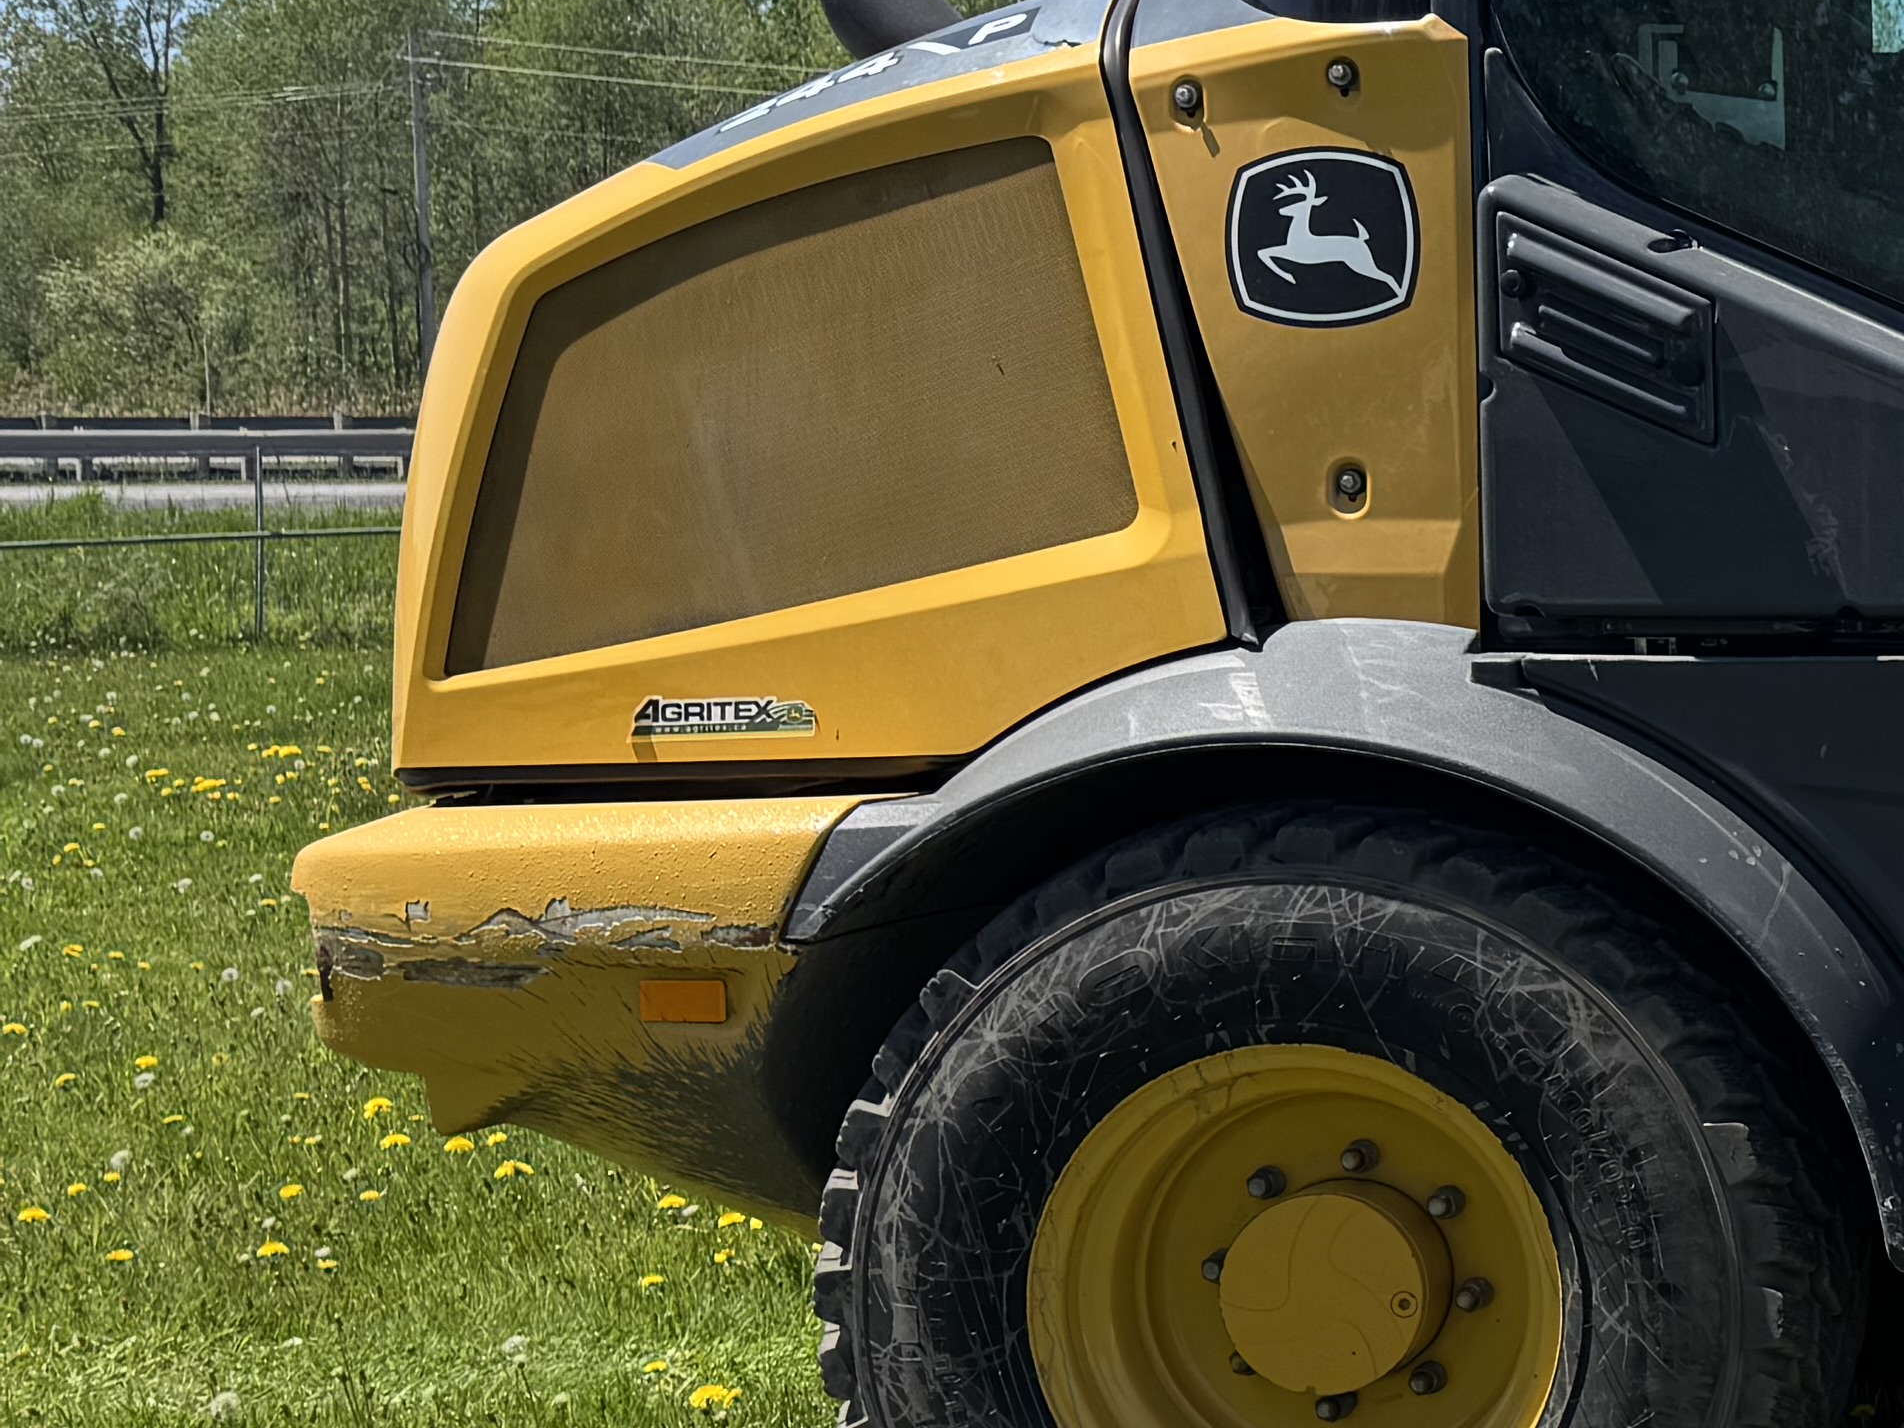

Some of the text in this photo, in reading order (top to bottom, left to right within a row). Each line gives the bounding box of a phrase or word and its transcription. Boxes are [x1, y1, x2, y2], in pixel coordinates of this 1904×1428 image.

[967, 13, 1028, 45] P
[634, 698, 774, 723] AGRITEX
[655, 724, 747, 734] www.agritex.ca
